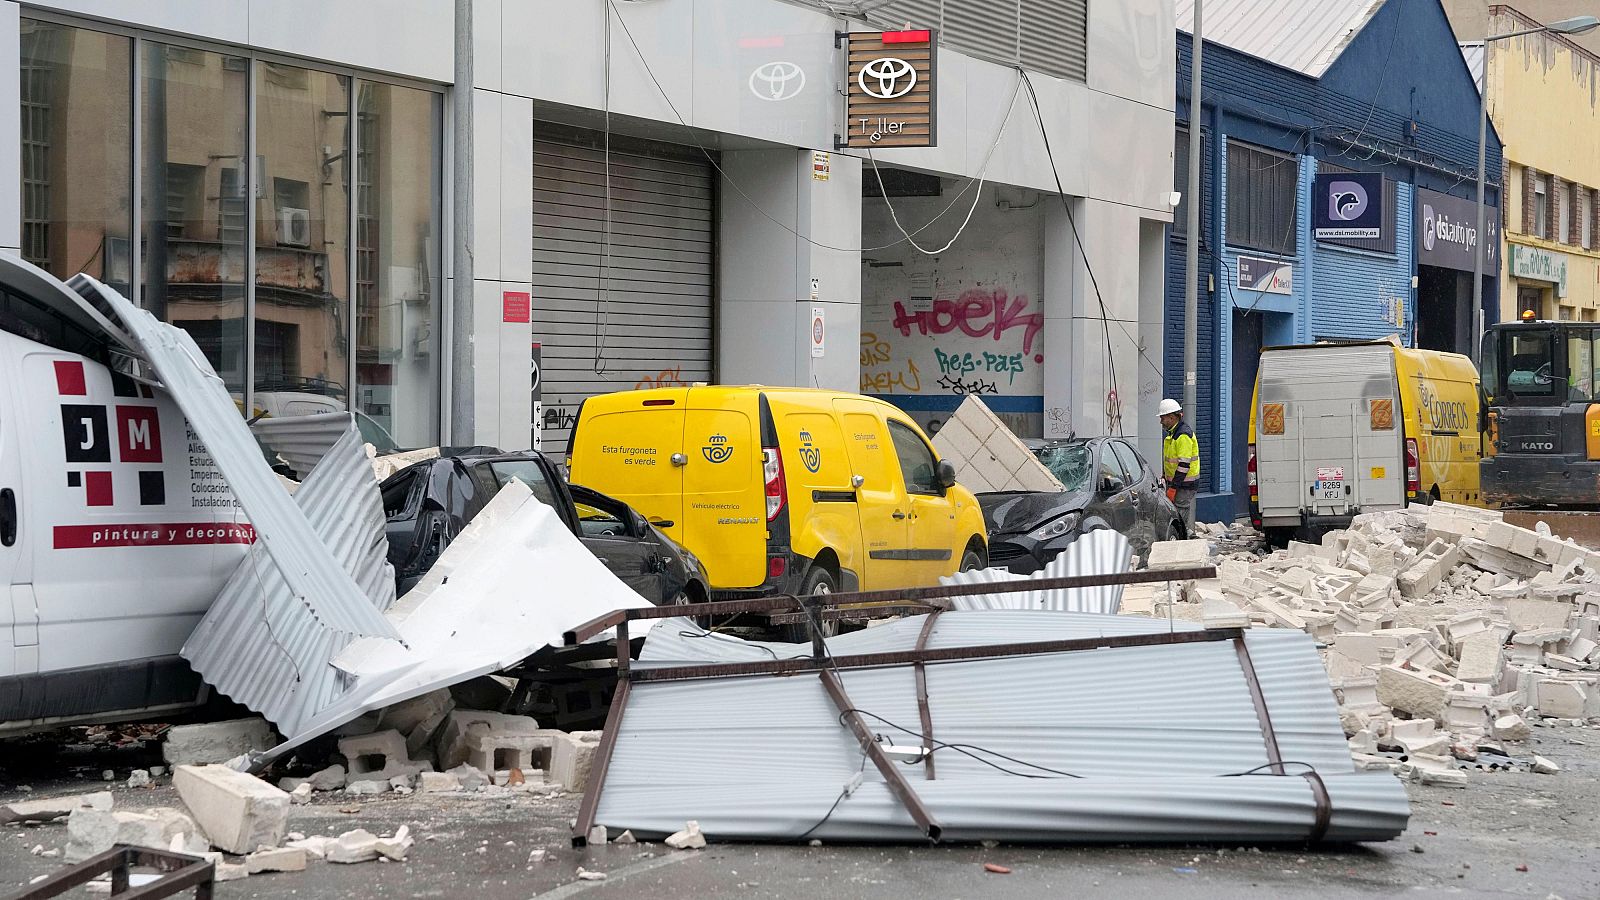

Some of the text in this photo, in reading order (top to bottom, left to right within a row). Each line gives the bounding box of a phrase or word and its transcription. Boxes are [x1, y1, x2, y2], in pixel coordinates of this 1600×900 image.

[602, 445, 657, 456] Esta furgoneta
[1521, 442, 1554, 450] KATO
[189, 456, 216, 467] Estuca
[634, 457, 656, 466] verde
[191, 482, 230, 494] Colocación
[1324, 490, 1339, 499] KFJ
[717, 516, 760, 525] RENAULT
[92, 527, 258, 543] pintura y decoraci
